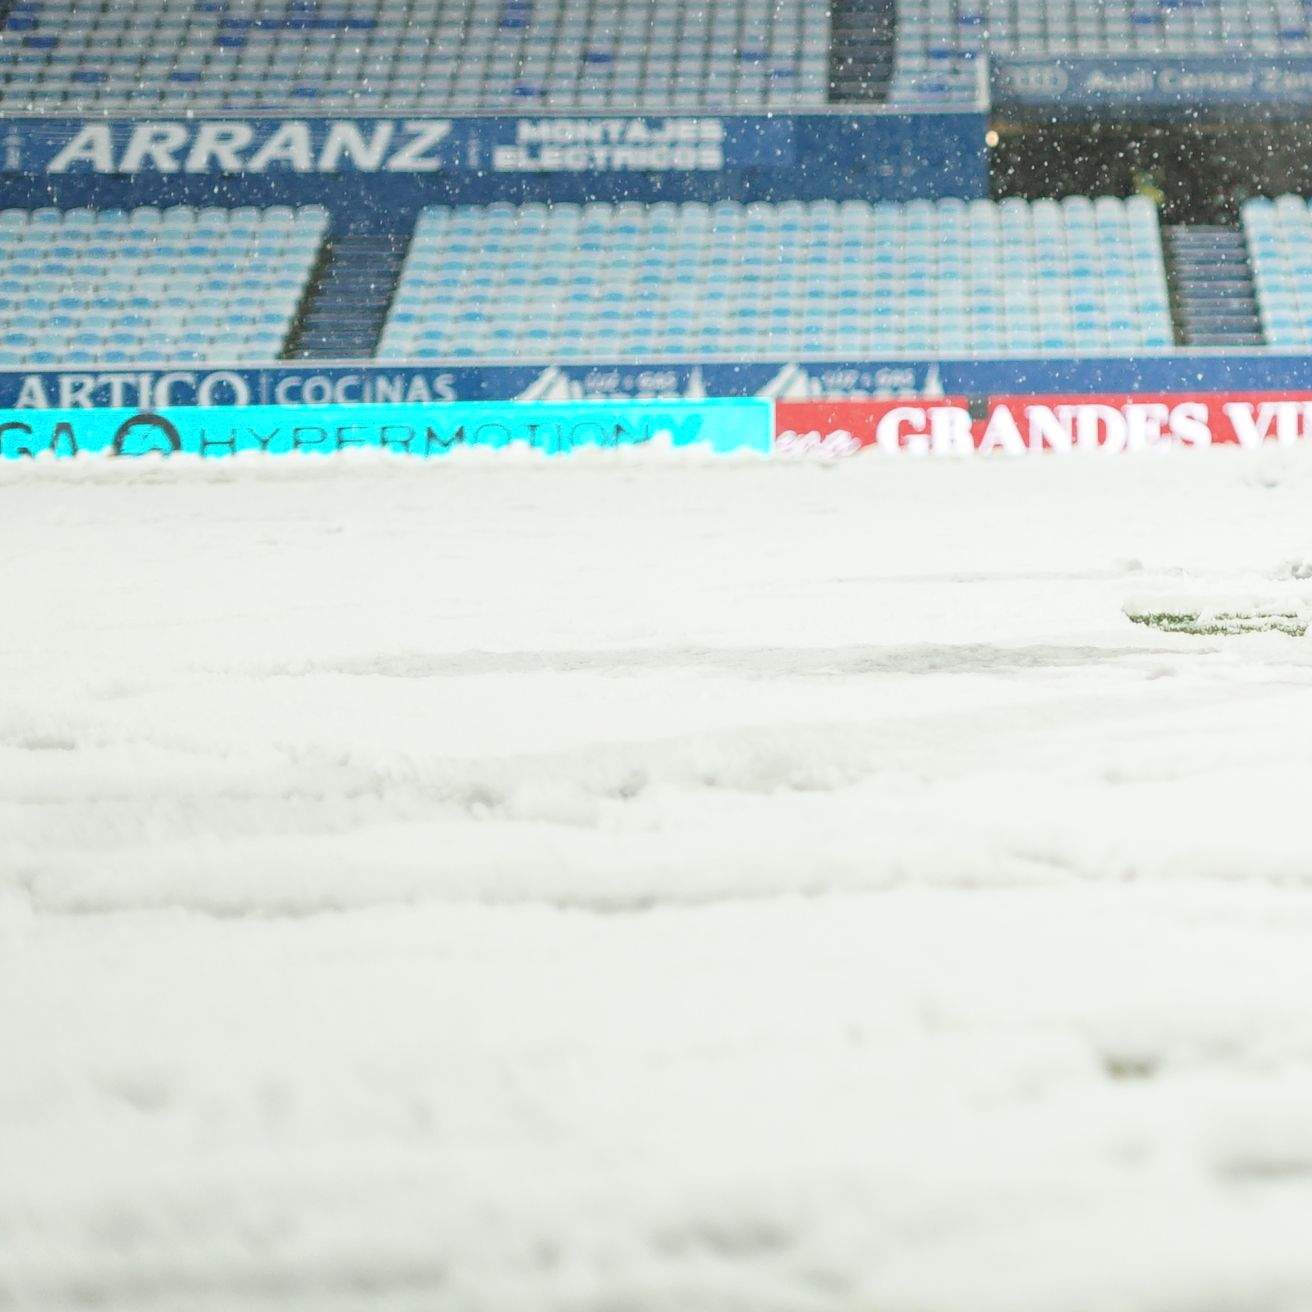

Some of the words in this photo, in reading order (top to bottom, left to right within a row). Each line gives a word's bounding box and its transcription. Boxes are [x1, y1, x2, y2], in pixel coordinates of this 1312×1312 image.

[47, 119, 451, 175] ARRANZ
[14, 371, 250, 409] ARTICO
[275, 372, 458, 406] COCINAS
[876, 402, 1213, 457] GRANDES
